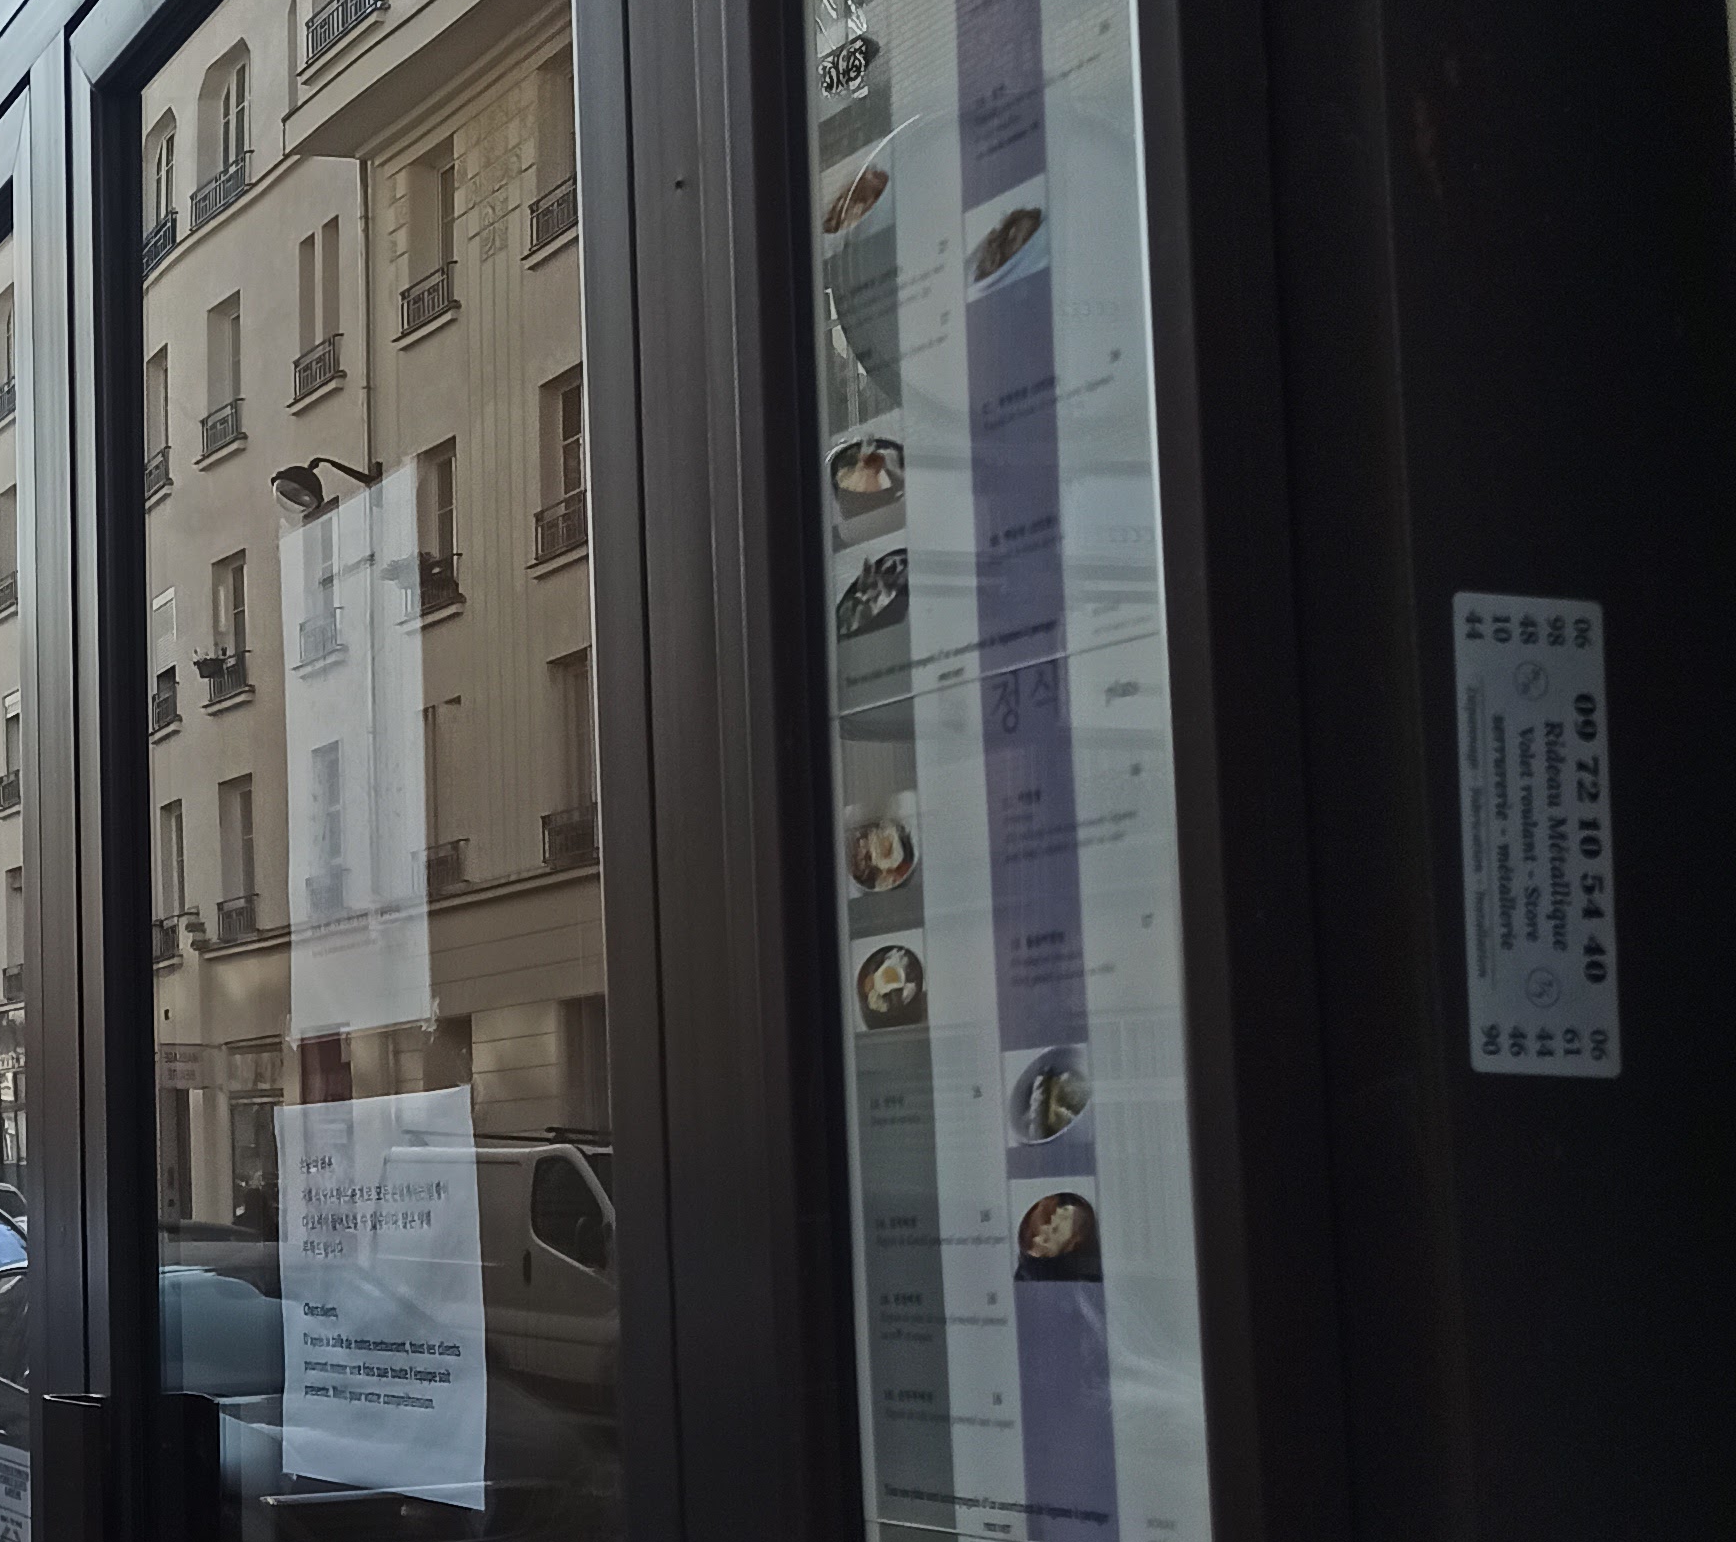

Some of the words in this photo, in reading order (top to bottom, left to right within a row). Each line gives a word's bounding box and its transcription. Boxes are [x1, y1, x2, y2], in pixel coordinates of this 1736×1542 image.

[1492, 615, 1512, 644] 10
[1574, 692, 1598, 743] 09
[1519, 726, 1537, 778] Volet
[1544, 719, 1566, 808] Rideau
[1575, 756, 1601, 804] 72
[1519, 783, 1539, 862] roulant
[1578, 817, 1603, 859] 10
[1496, 842, 1516, 951] métallerie
[1545, 816, 1572, 951] Métallique
[1580, 872, 1605, 920] 54
[1524, 884, 1541, 943] Store
[1583, 934, 1608, 985] 40
